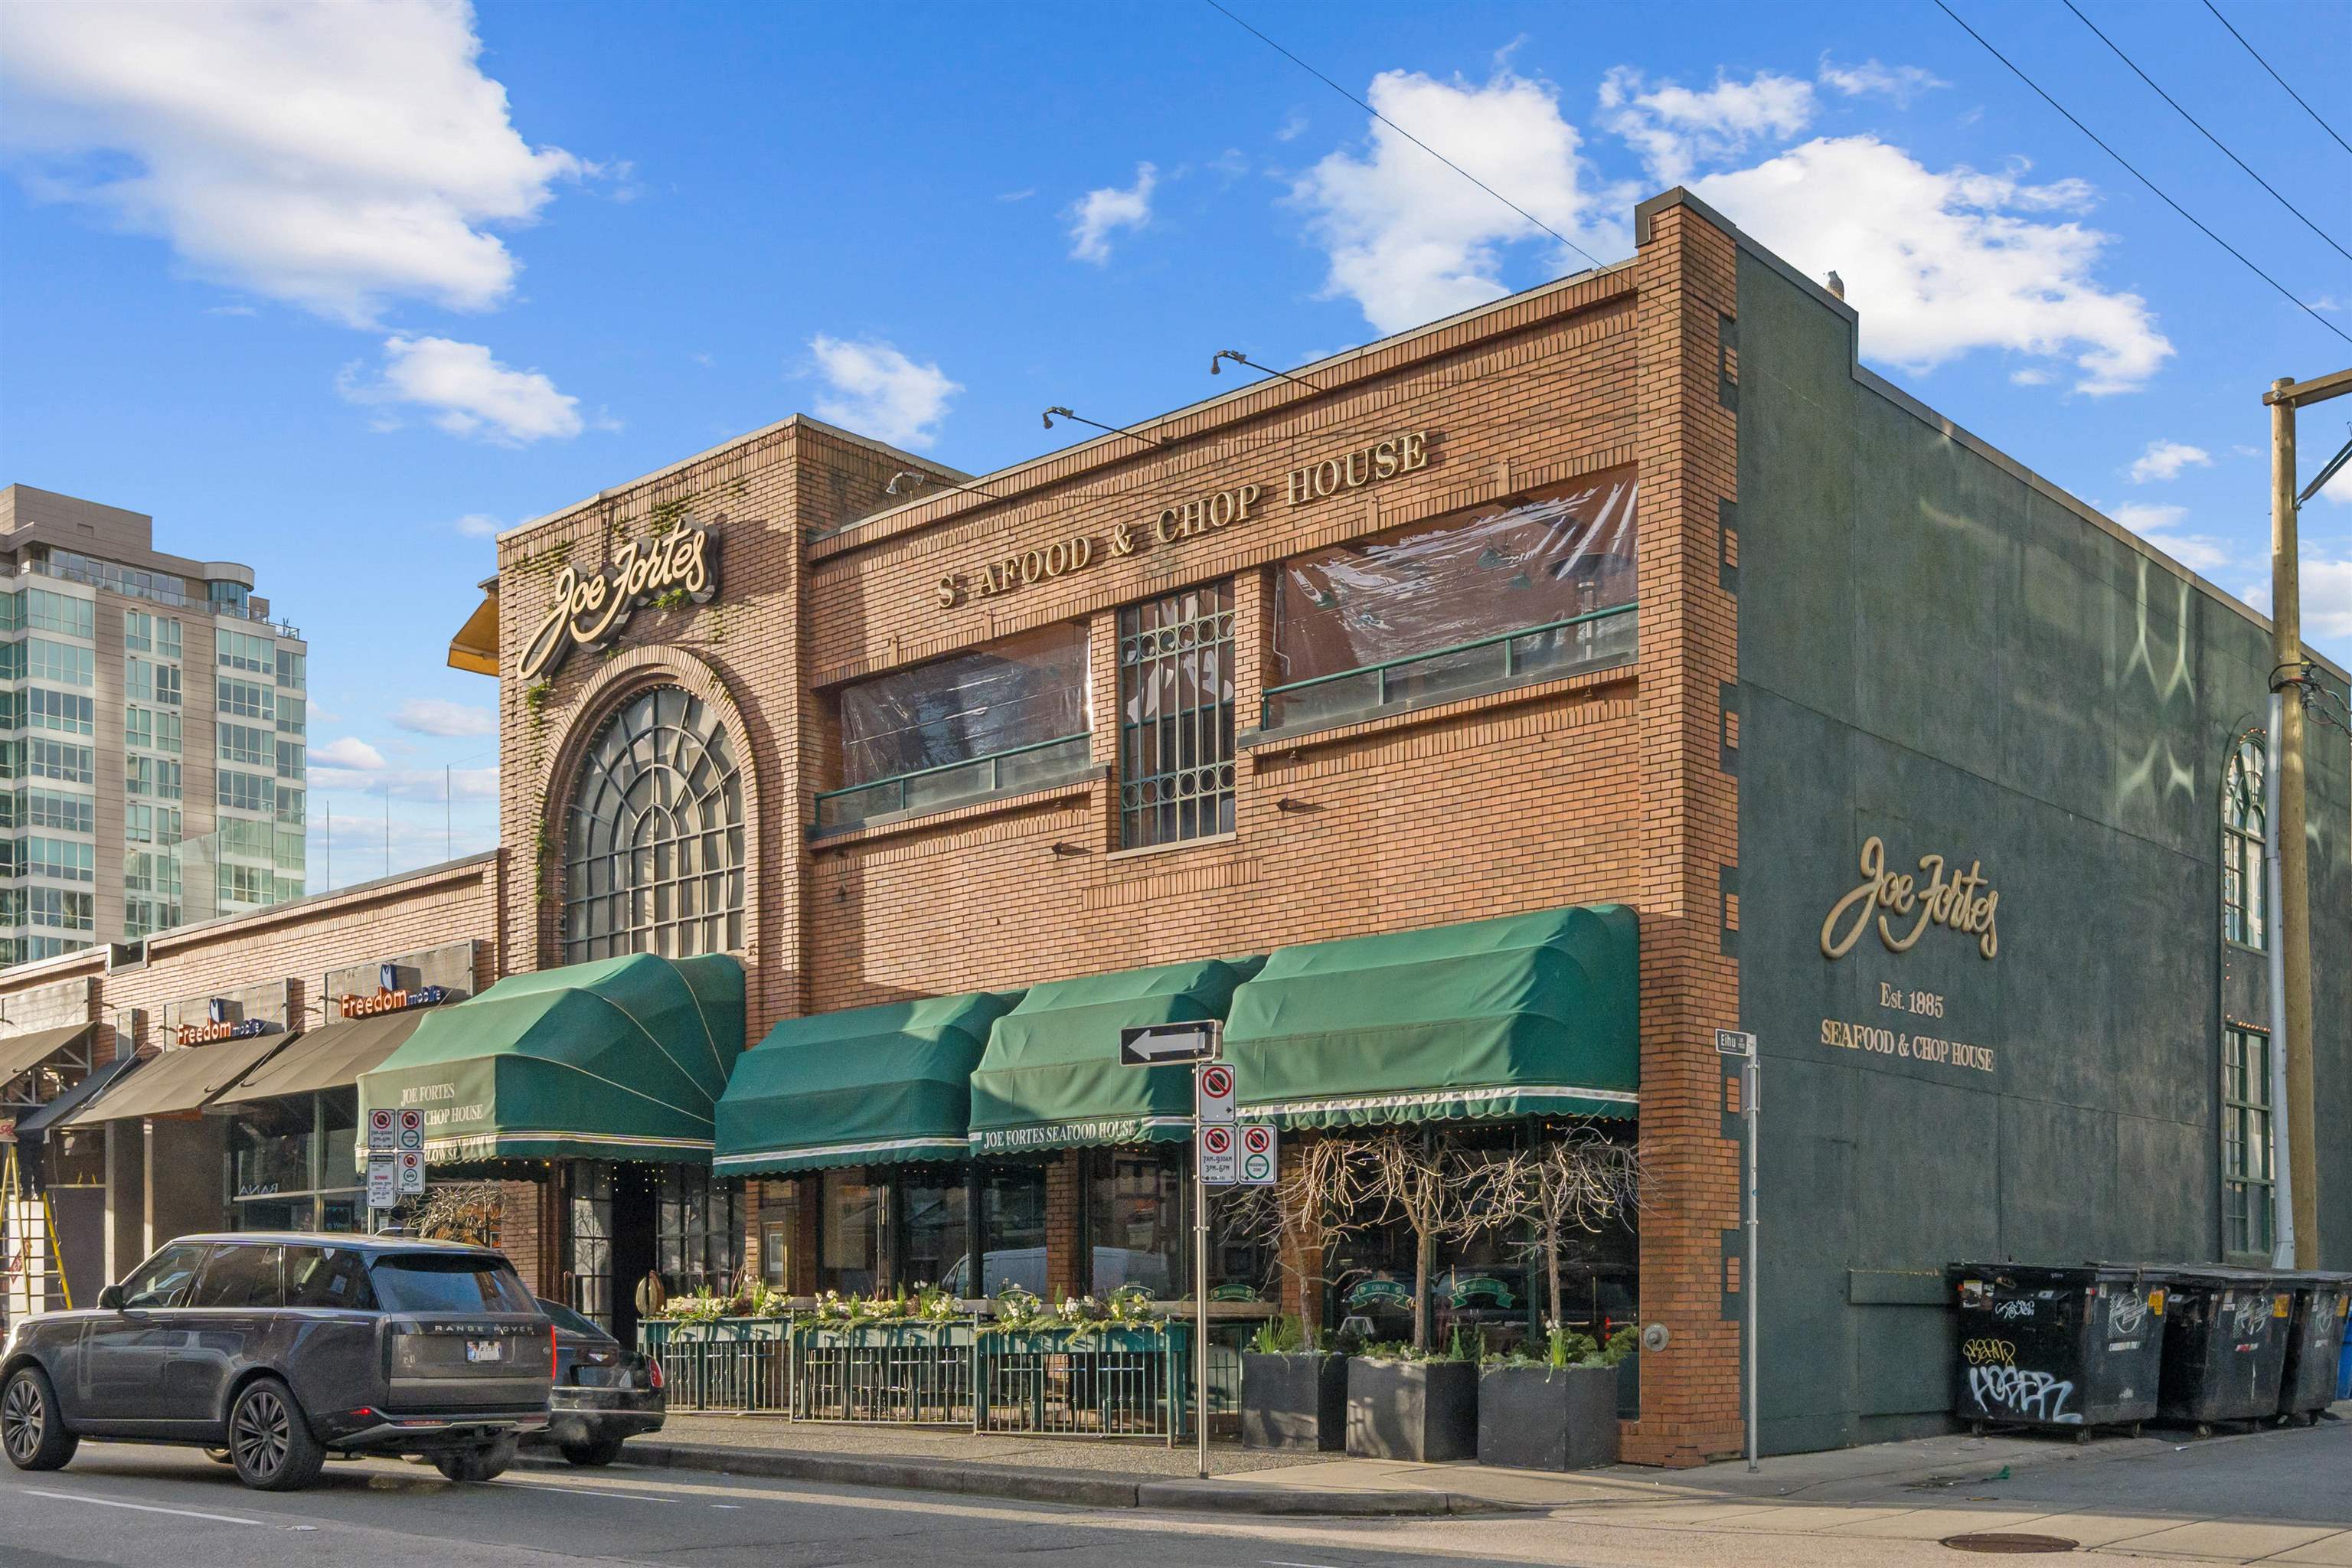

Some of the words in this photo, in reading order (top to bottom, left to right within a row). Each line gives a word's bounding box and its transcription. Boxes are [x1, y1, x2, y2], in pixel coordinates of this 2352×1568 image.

[1112, 522, 1135, 557] &
[1156, 483, 1262, 543] CHOP
[1286, 430, 1429, 506] HOUSE
[516, 567, 606, 680] Joe
[570, 519, 706, 643] Fortes
[1821, 836, 1915, 959] Joe
[1878, 854, 1999, 960] Fortes
[341, 987, 408, 1018] Freedom
[407, 987, 443, 1007] mobile
[1880, 982, 1905, 1010] Est.
[1909, 991, 1944, 1018] 1985
[177, 1018, 231, 1045] Freedom
[231, 1020, 261, 1037] mobile
[1720, 1034, 1736, 1047] Eihu
[1821, 1018, 1894, 1054] SEAFOOD
[1898, 1033, 1910, 1057] &
[1913, 1036, 1949, 1063] CHOP
[1952, 1042, 1994, 1072] HOUSE
[400, 1087, 418, 1107] JOE
[420, 1083, 456, 1102] FORTES
[424, 1108, 450, 1125] CHOP
[452, 1104, 483, 1122] HOUSE
[984, 1131, 1004, 1149] JOE
[1006, 1128, 1045, 1146] FORTES
[1046, 1123, 1096, 1143] SEAFOOD
[1099, 1119, 1137, 1139] HOUSE
[1205, 1165, 1230, 1173] 3PM-6PM
